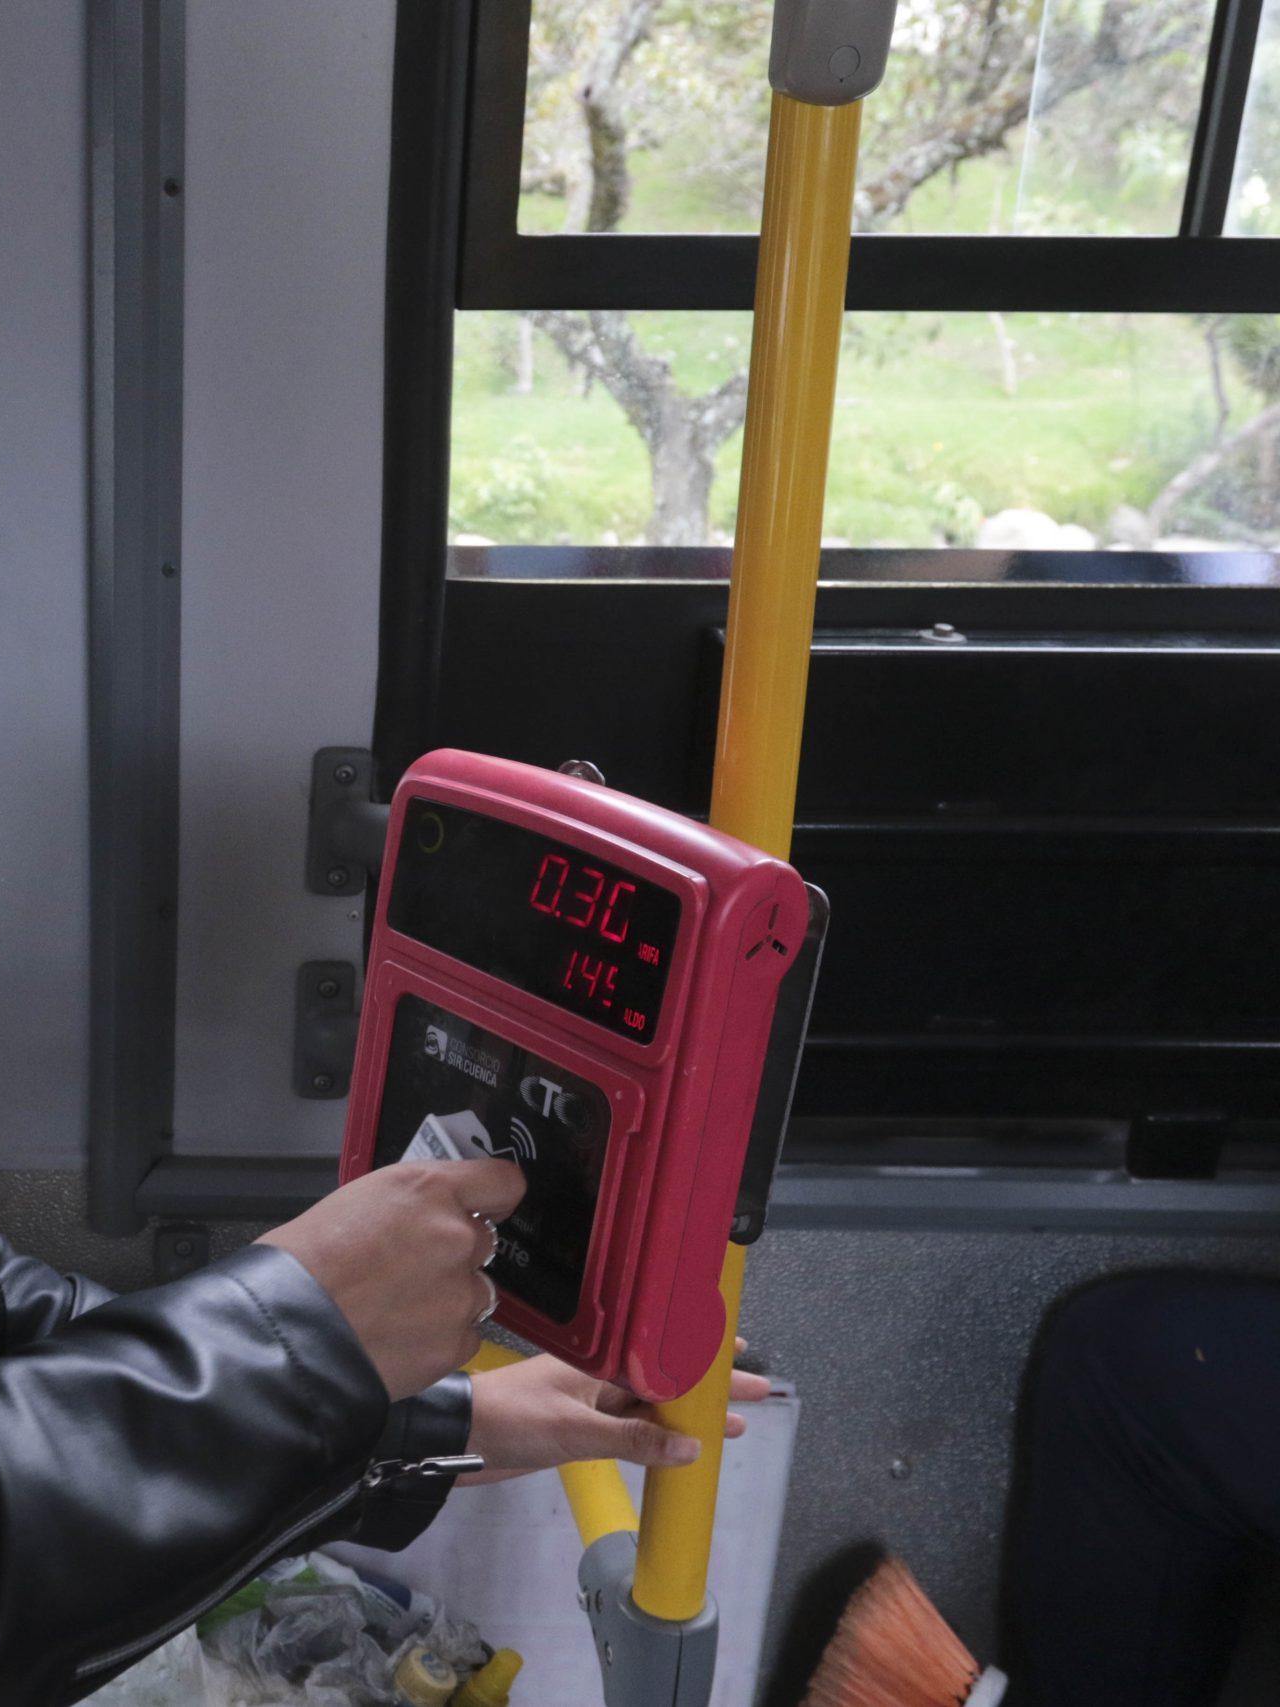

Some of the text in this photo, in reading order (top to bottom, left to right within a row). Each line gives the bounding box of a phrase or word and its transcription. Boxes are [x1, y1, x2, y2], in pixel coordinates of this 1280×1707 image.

[529, 854, 636, 944] 0.30
[623, 1008, 647, 1031] ALDO
[446, 1051, 497, 1088] SIR CUENCA
[448, 1037, 501, 1073] CONSORCIO
